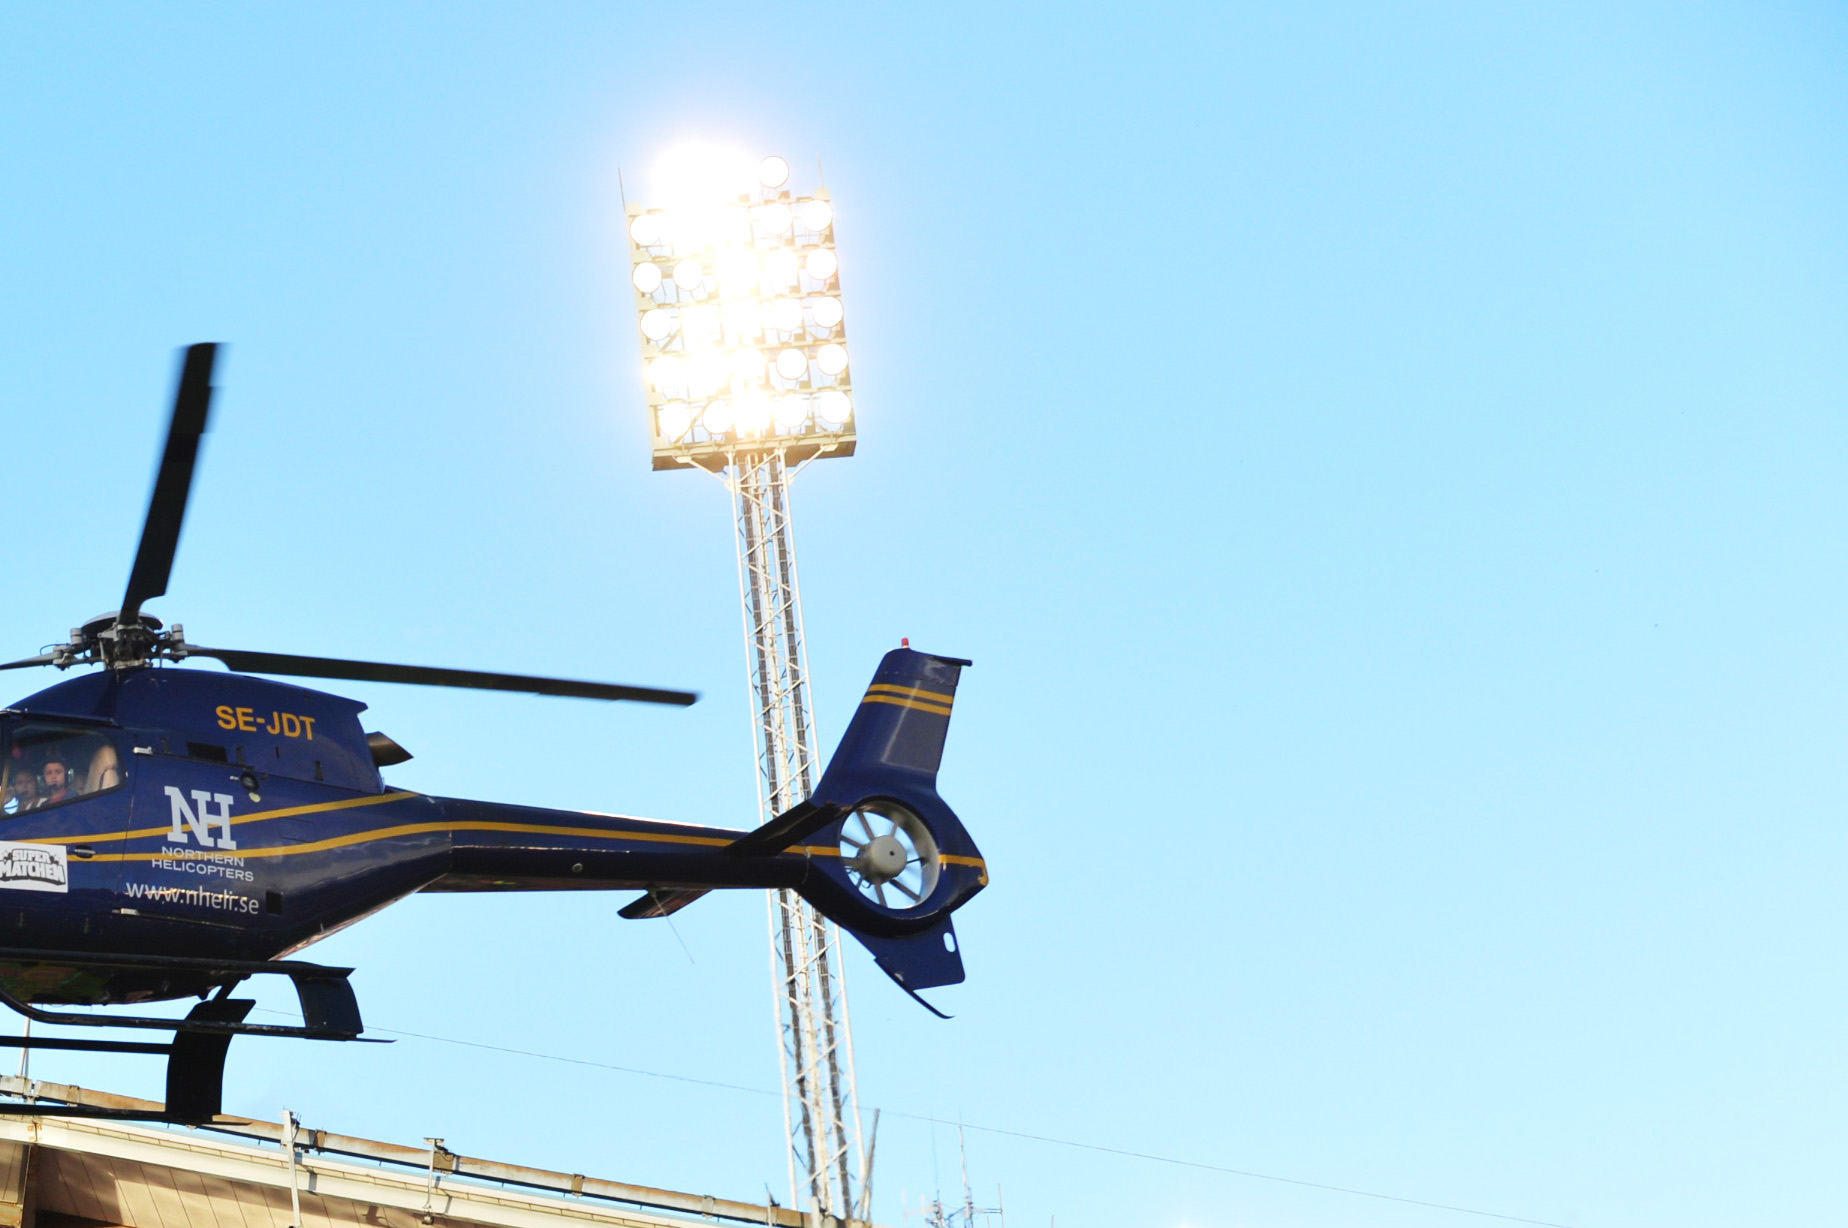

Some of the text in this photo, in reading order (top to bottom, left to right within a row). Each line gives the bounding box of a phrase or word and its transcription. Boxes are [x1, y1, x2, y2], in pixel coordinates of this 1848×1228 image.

[215, 704, 316, 741] SE-JDT
[164, 785, 238, 850] NH
[12, 848, 52, 864] SUPER
[151, 858, 255, 881] HELICOPTERS
[161, 845, 245, 867] NORTHERN
[124, 881, 260, 915] www.nheli.se
